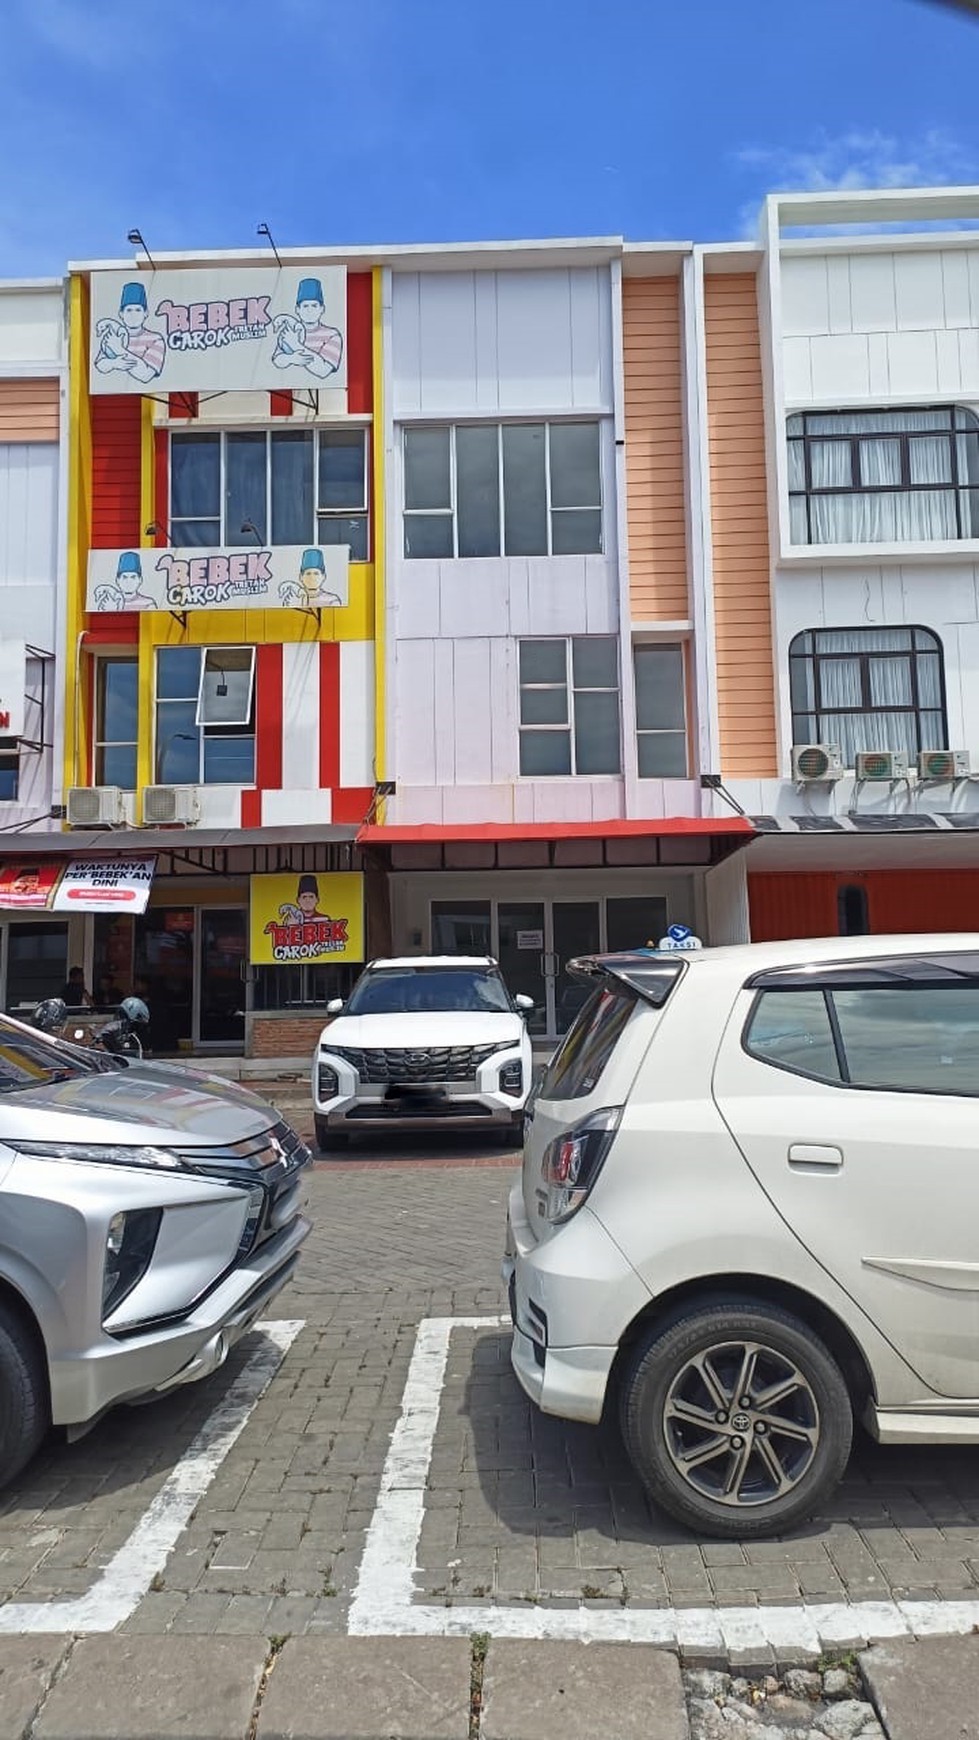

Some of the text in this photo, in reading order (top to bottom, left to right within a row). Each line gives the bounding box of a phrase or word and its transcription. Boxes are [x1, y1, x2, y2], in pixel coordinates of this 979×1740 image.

[156, 296, 272, 331] BEBEK
[168, 326, 231, 350] CAROK
[156, 552, 272, 587] BEBEK
[167, 580, 231, 606] CAROK
[76, 863, 147, 871] WAKTUNYA
[92, 879, 118, 887] DINI
[264, 919, 349, 947] BEBEK
[273, 942, 321, 961] CAROK
